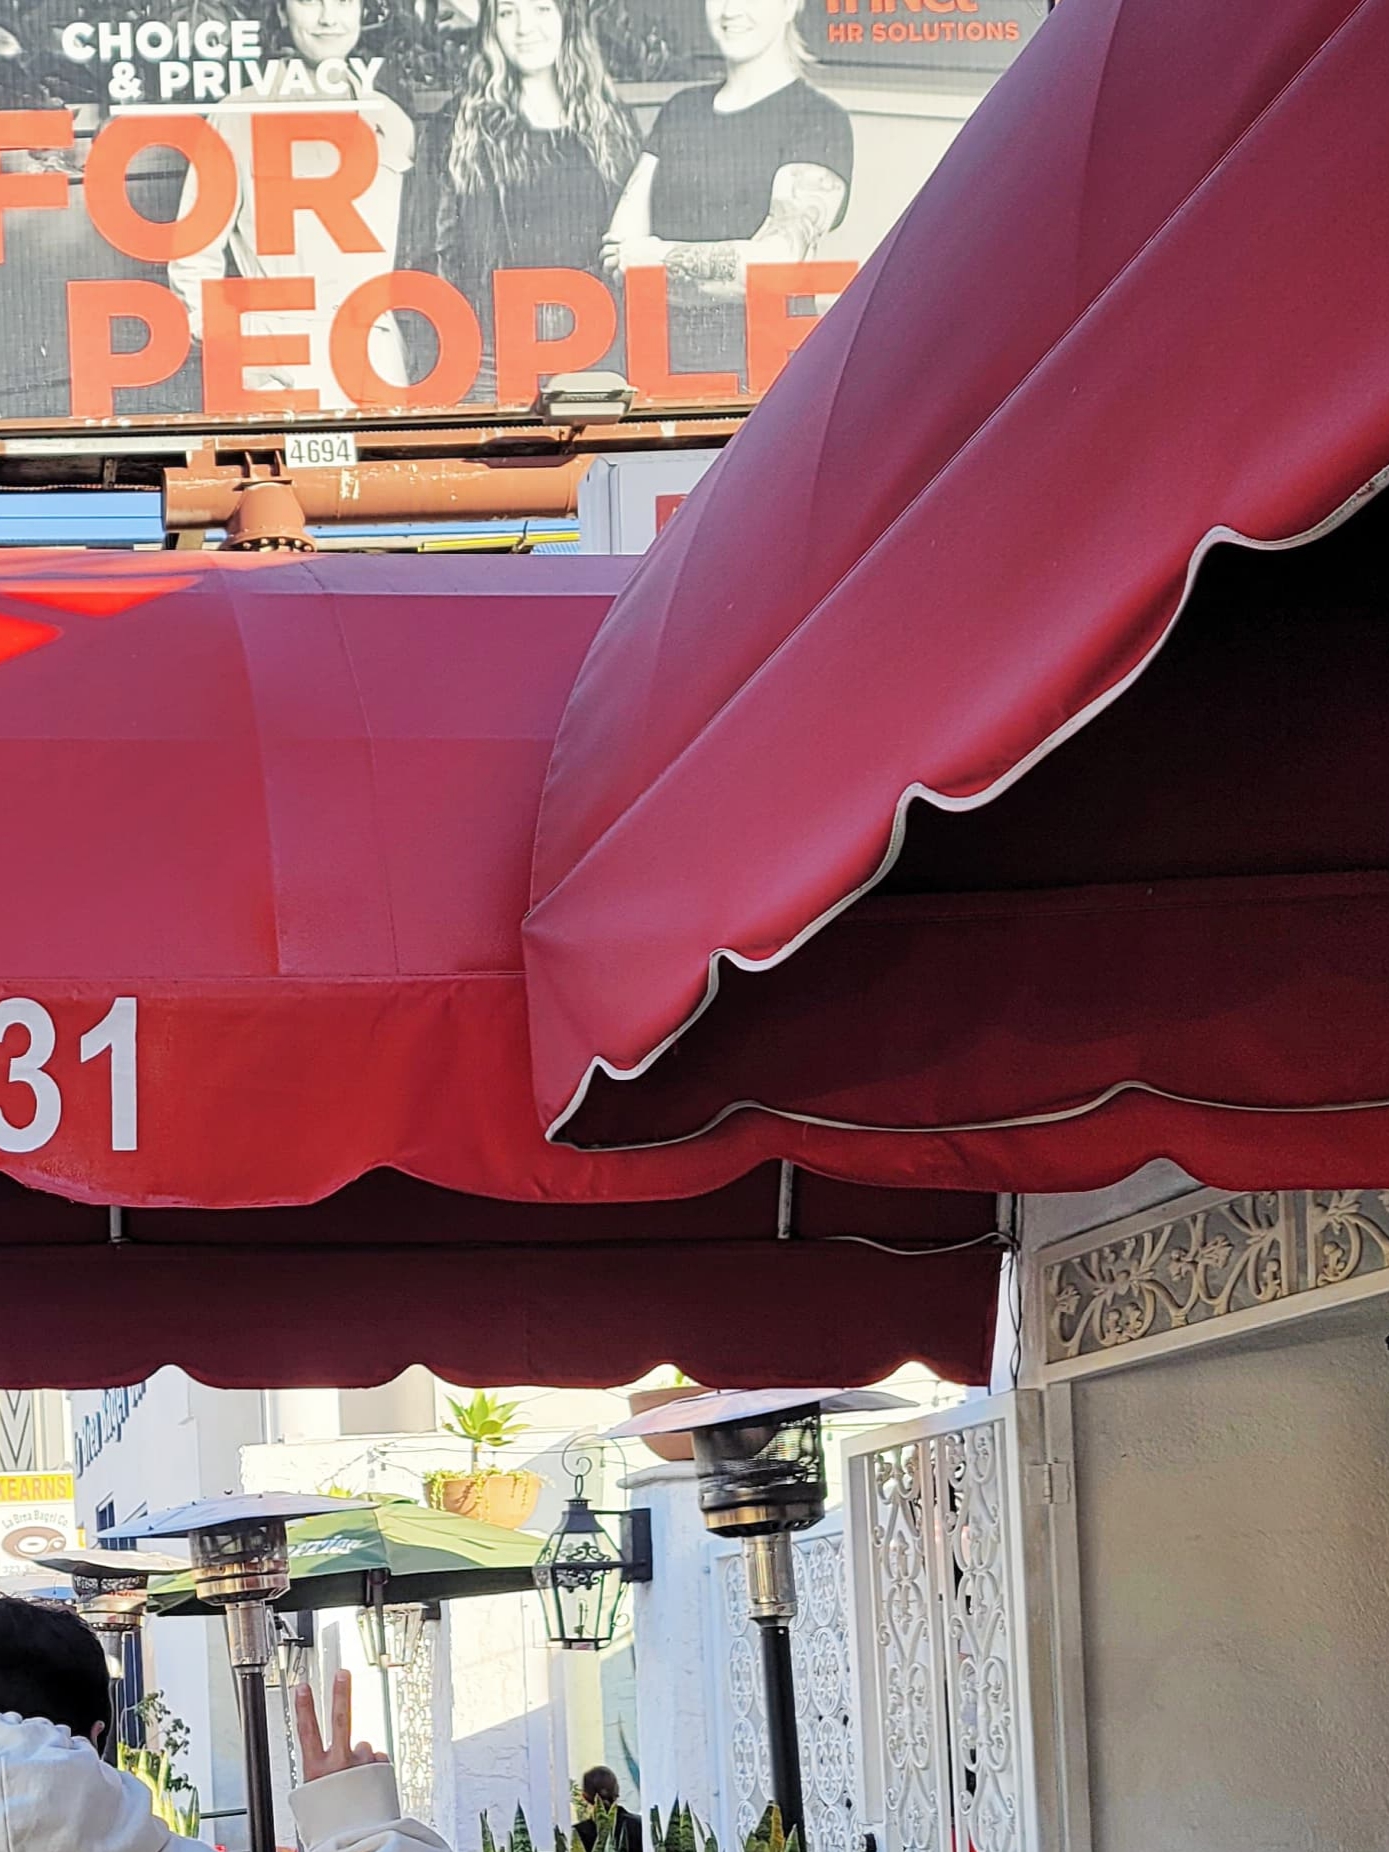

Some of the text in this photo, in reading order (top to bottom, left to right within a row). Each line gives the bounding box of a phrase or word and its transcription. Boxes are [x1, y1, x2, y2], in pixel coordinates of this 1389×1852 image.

[61, 20, 262, 61] CHOICE
[828, 21, 1020, 43] HR SOLUTIONS
[108, 56, 385, 100] & PRIVACY
[290, 439, 353, 463] 4694
[13, 1511, 33, 1524] Brea
[33, 1509, 57, 1524] Bagel
